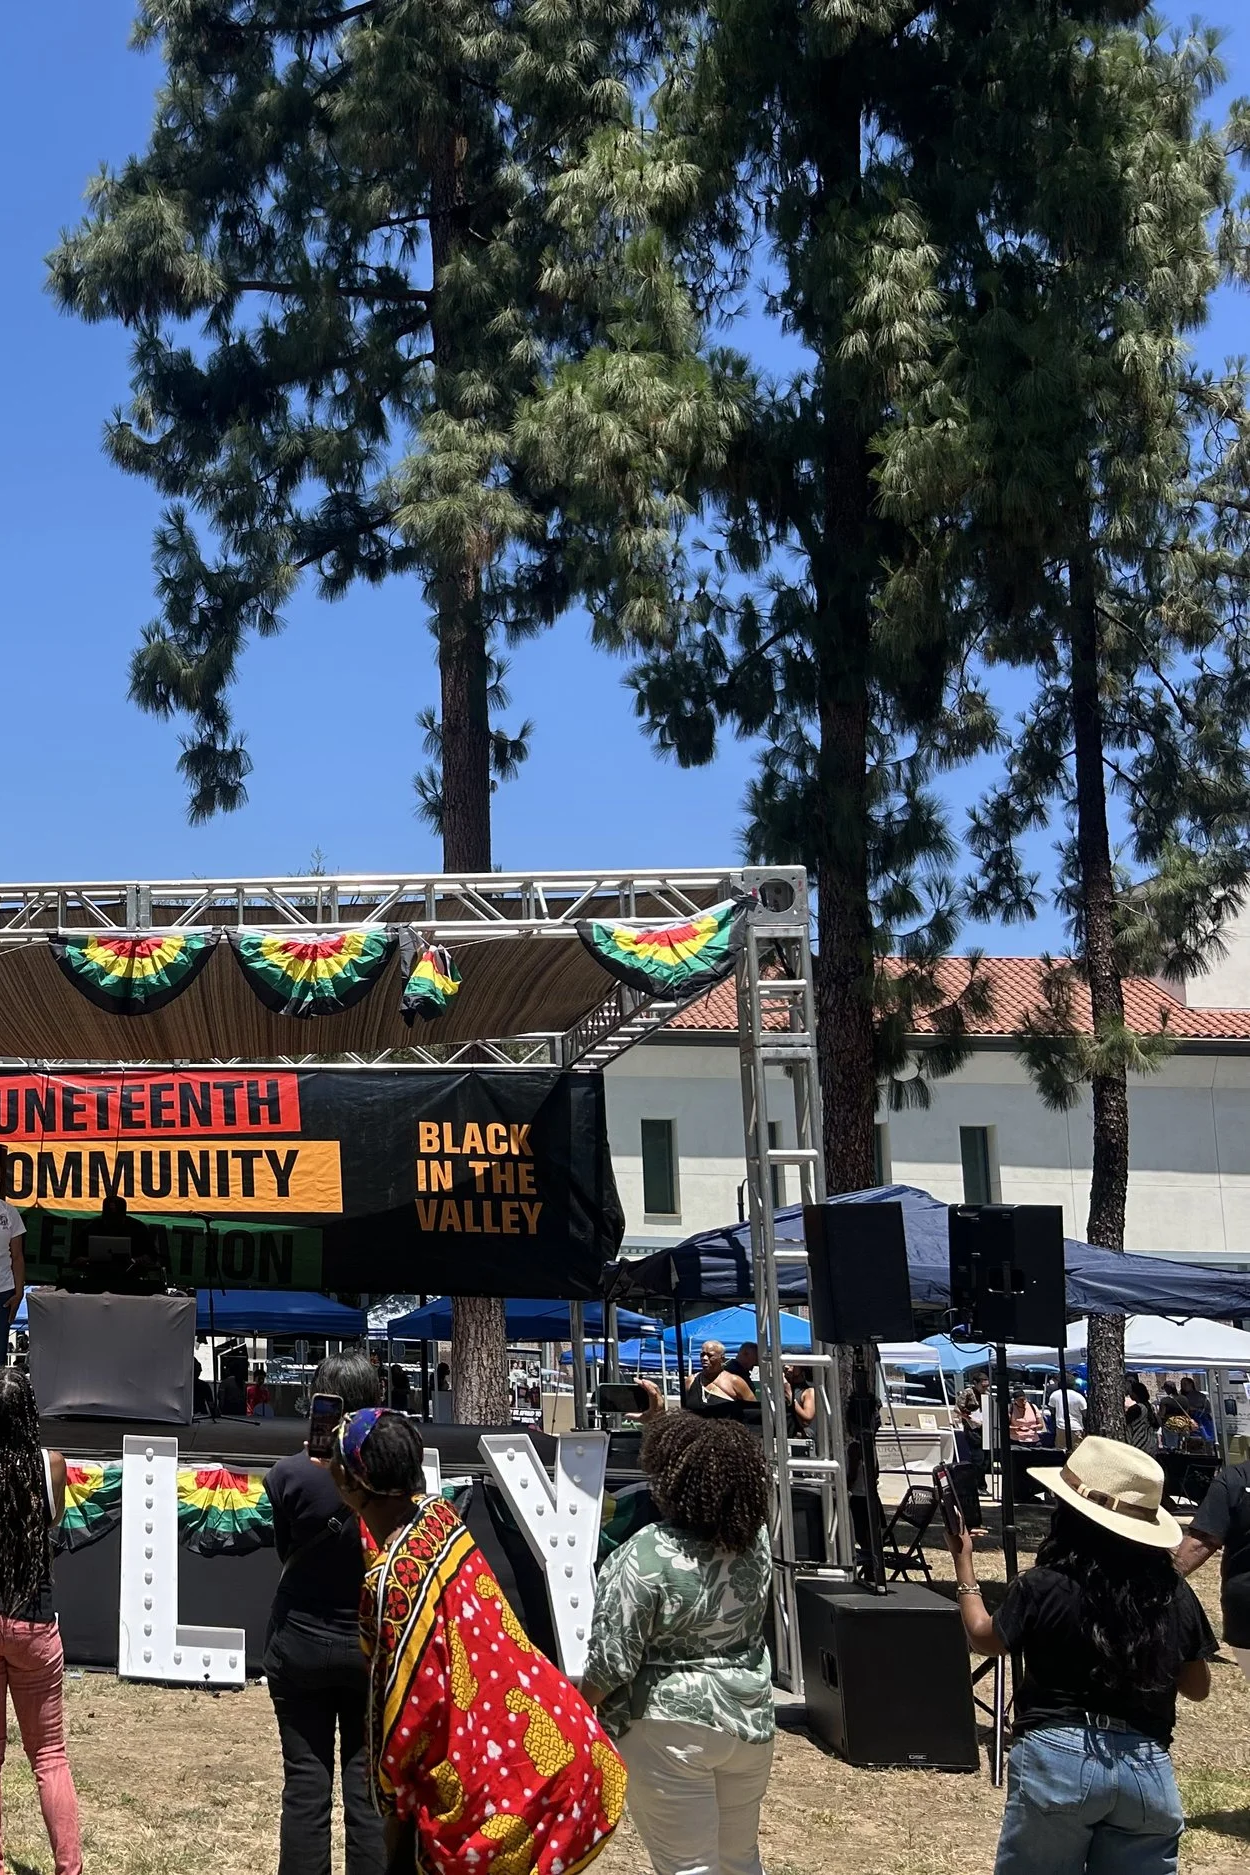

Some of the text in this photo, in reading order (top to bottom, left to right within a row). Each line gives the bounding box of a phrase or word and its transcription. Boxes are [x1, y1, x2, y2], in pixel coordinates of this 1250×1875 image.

[418, 1121, 534, 1157] BLACK
[4, 1148, 300, 1201] OMMUNITY
[416, 1159, 537, 1195] IN THE
[414, 1198, 543, 1235] VALLEY
